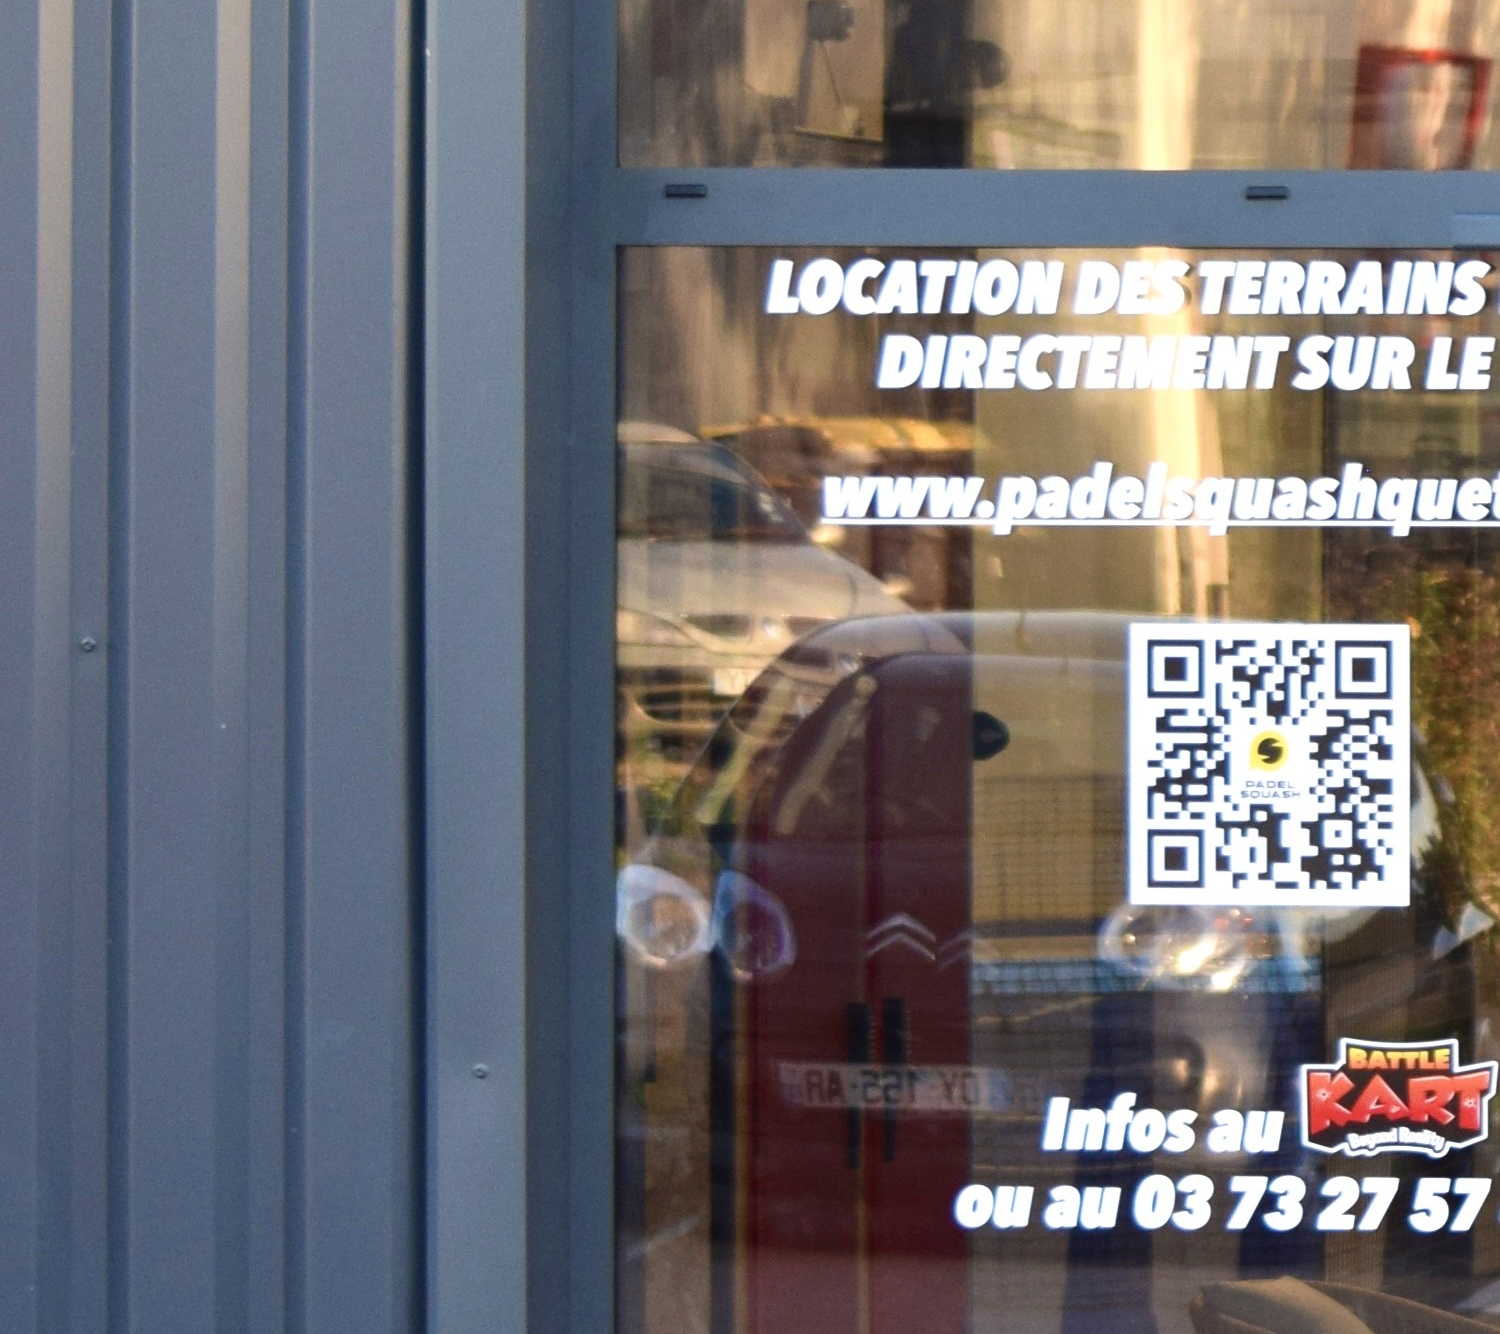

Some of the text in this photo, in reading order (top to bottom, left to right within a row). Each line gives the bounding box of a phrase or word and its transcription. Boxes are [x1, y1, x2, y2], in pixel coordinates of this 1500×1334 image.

[766, 259, 1064, 316] LOCATION
[1073, 259, 1190, 316] DES
[1199, 261, 1491, 316] TERRAINS
[878, 334, 1290, 390] DIRECTEMENT
[1291, 335, 1416, 390] SUR
[1427, 336, 1496, 390] LE
[1240, 790, 1301, 799] SQUASH
[1245, 780, 1295, 789] PADEL
[1349, 1047, 1450, 1070] BATTLE
[1043, 1092, 1285, 1154] Infos au
[1308, 1070, 1491, 1137] KART
[956, 1184, 1035, 1229] ou
[1044, 1185, 1122, 1229] au
[1134, 1174, 1214, 1230] 03
[1227, 1175, 1306, 1231] 73
[1316, 1175, 1400, 1231] 27
[1409, 1177, 1492, 1232] 57
